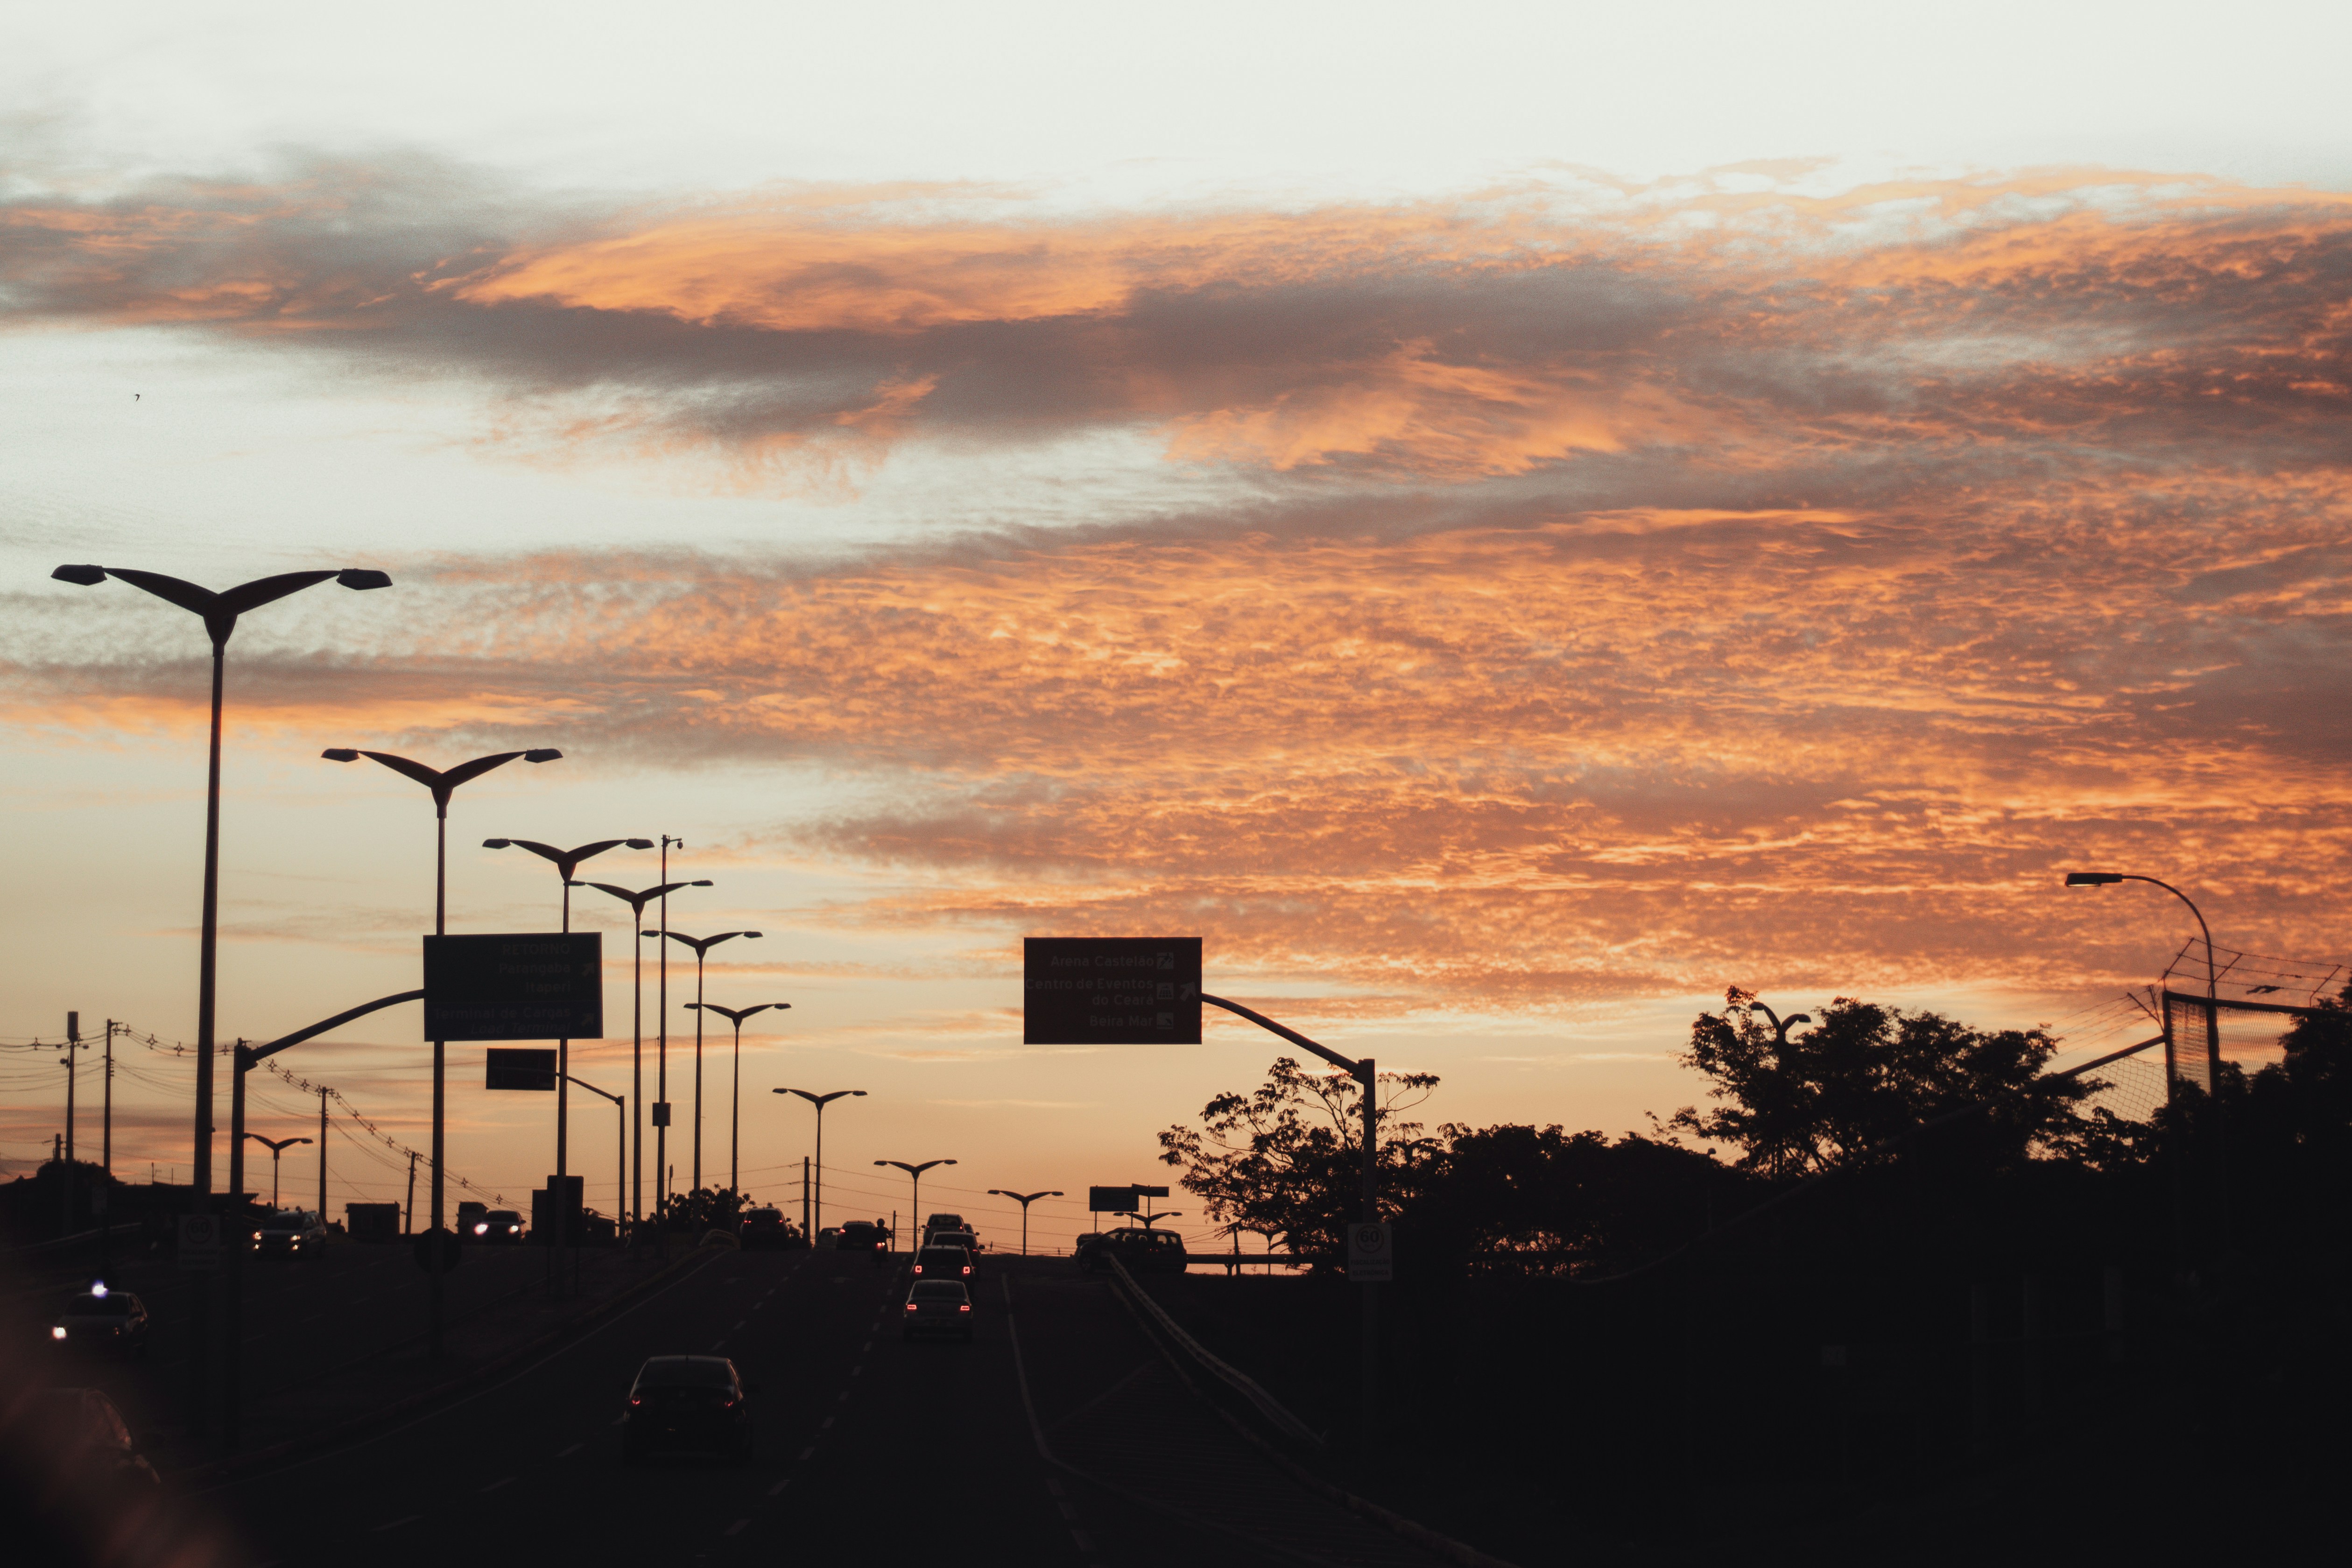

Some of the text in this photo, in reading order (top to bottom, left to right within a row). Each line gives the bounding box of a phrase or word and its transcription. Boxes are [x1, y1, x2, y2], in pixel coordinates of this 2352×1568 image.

[502, 943, 570, 955] RETORNO
[1050, 956, 1154, 967] Arena Castelão
[499, 962, 571, 977] Parangaba
[526, 980, 571, 995] Itaperi
[1025, 978, 1154, 990] Centro de Eventos
[1092, 994, 1154, 1005] do Ceará
[433, 1007, 571, 1020] Terminal de Cargas
[1090, 1015, 1153, 1027] Beira Mar
[471, 1021, 570, 1034] Load Terminal
[190, 1222, 209, 1233] 60
[1360, 1230, 1379, 1242] 60
